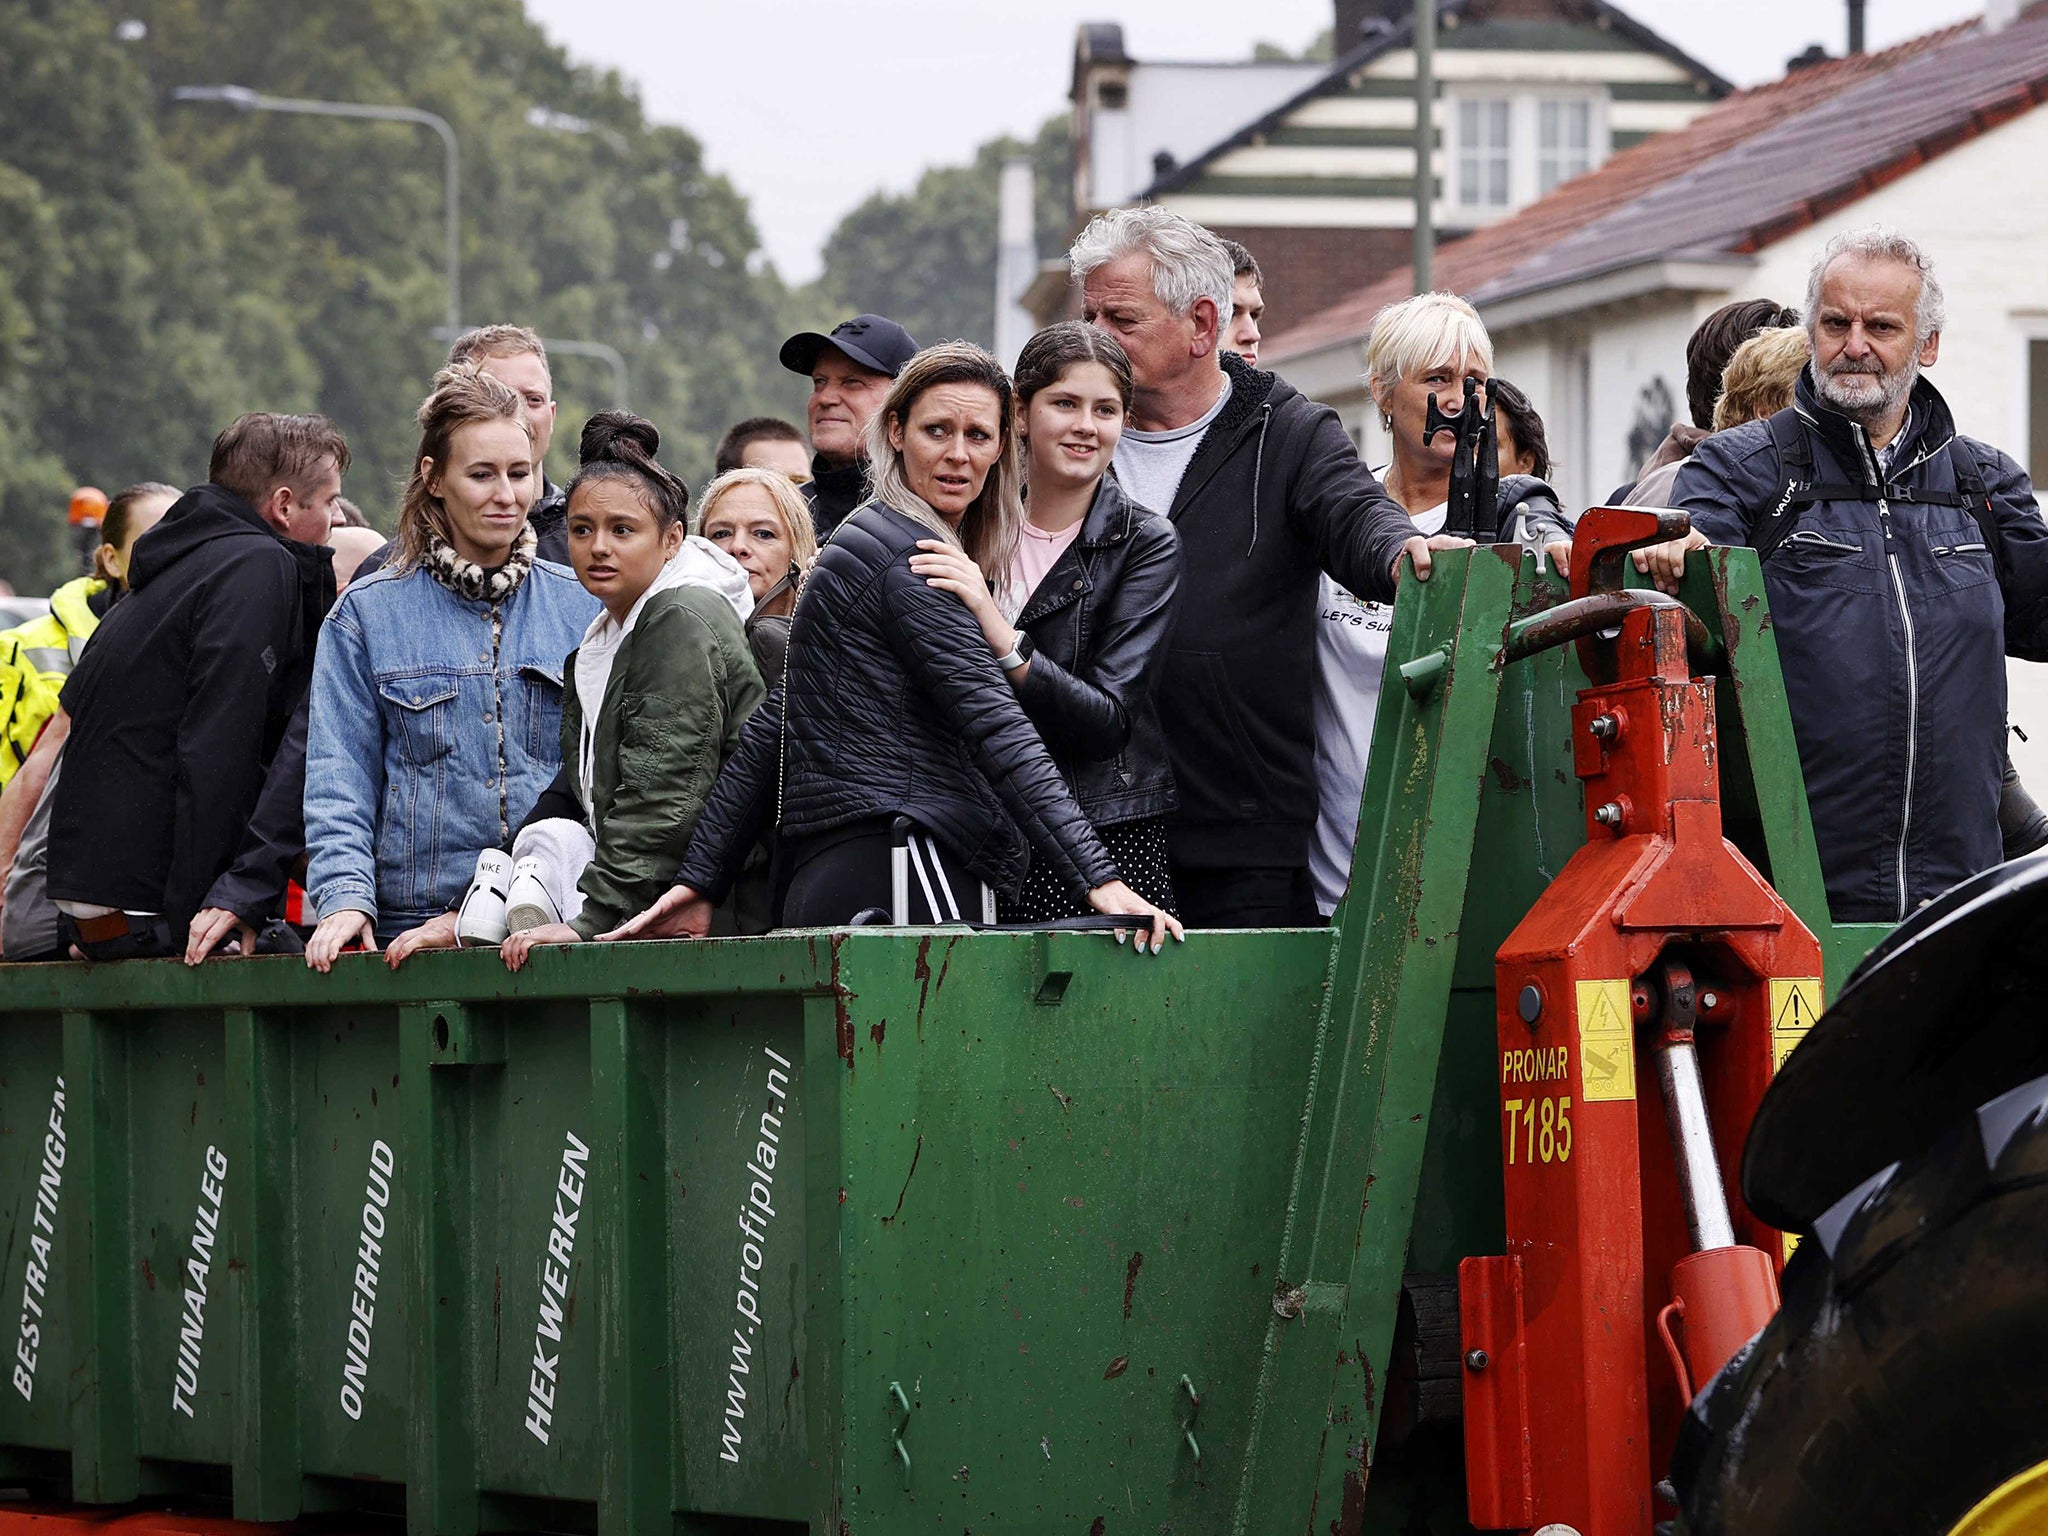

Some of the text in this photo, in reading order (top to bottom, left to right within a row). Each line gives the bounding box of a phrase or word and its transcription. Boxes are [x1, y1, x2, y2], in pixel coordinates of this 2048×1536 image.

[1321, 608, 1362, 626] LET'S
[480, 862, 501, 874] NIKE
[1503, 1046, 1568, 1084] PRONAR
[1505, 1096, 1573, 1165] T185
[173, 1145, 228, 1418] TUINAANLEG
[340, 1139, 395, 1421] ONDERHOUD
[524, 1131, 590, 1445] HEKWERKEN
[720, 1047, 792, 1463] www.profiplan.nl
